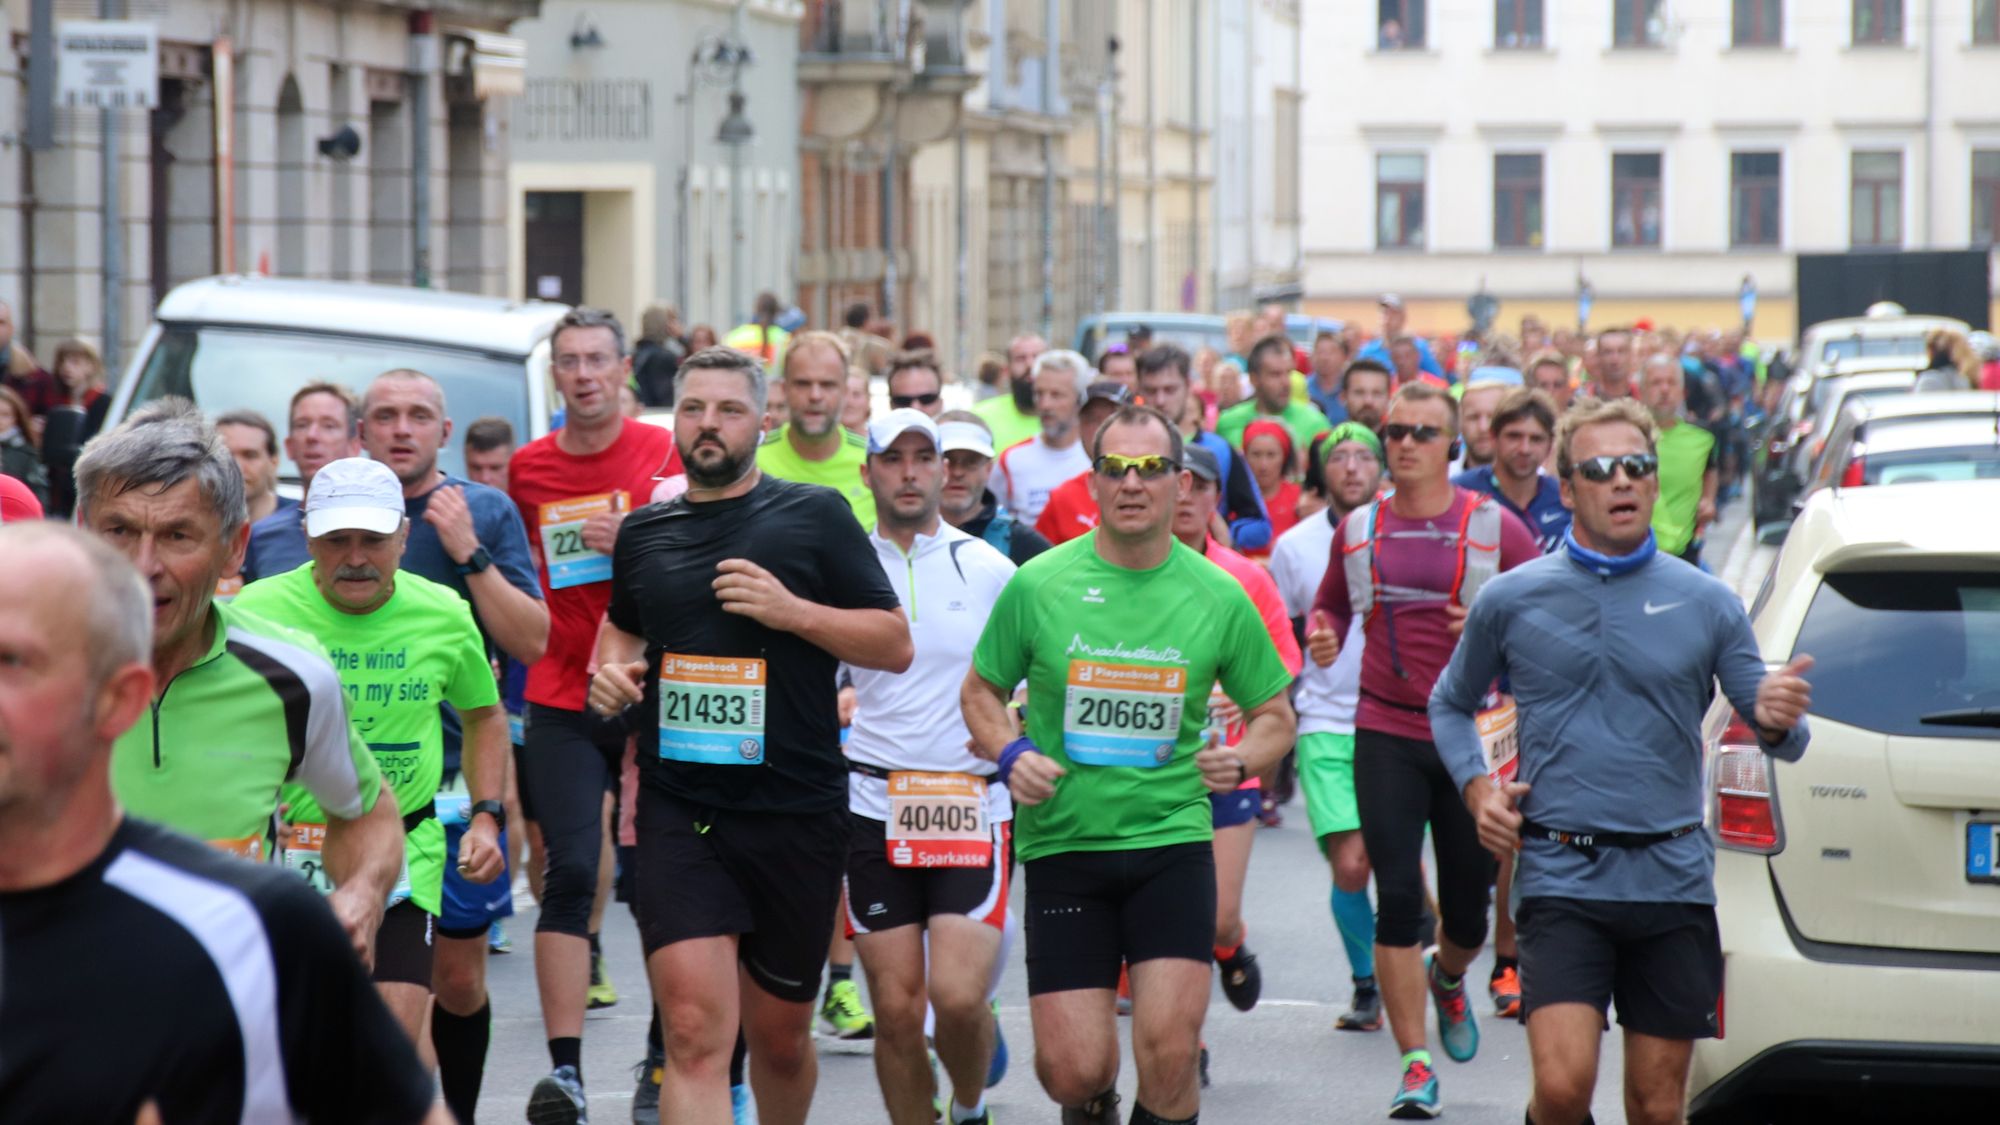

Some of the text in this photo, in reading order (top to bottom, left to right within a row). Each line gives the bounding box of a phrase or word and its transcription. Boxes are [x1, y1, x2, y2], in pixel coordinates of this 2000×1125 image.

[330, 647, 406, 671] the wind
[341, 677, 428, 708] n my side
[667, 690, 746, 726] 21433
[1078, 697, 1166, 731] 20663
[1809, 785, 1867, 799] TOYOTA
[899, 805, 977, 832] 40405
[918, 850, 988, 868] Sparkasse
